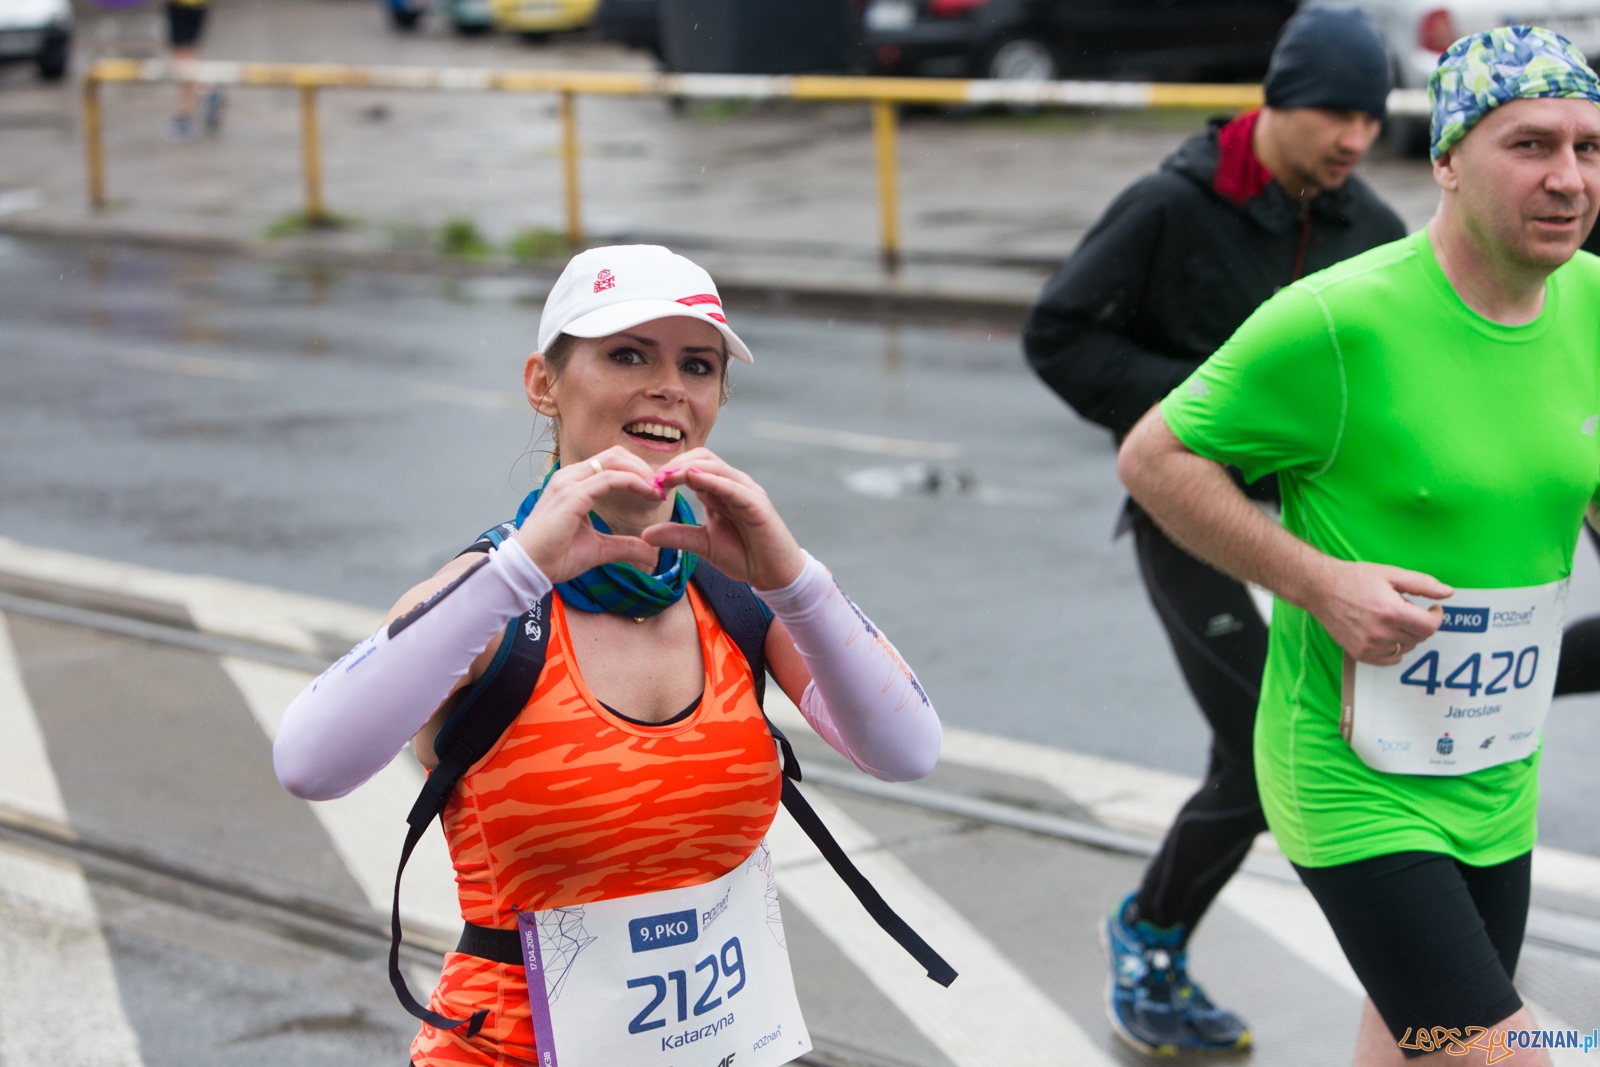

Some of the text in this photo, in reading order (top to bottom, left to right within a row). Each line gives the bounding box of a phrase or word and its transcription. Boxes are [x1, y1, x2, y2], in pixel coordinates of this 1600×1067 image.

[1454, 613, 1482, 627] PKO
[1400, 645, 1539, 697] 4420
[656, 920, 689, 938] PKO
[524, 930, 538, 971] 17.04.2016
[626, 936, 746, 1034] 2129
[661, 1012, 735, 1051] Katarzyna
